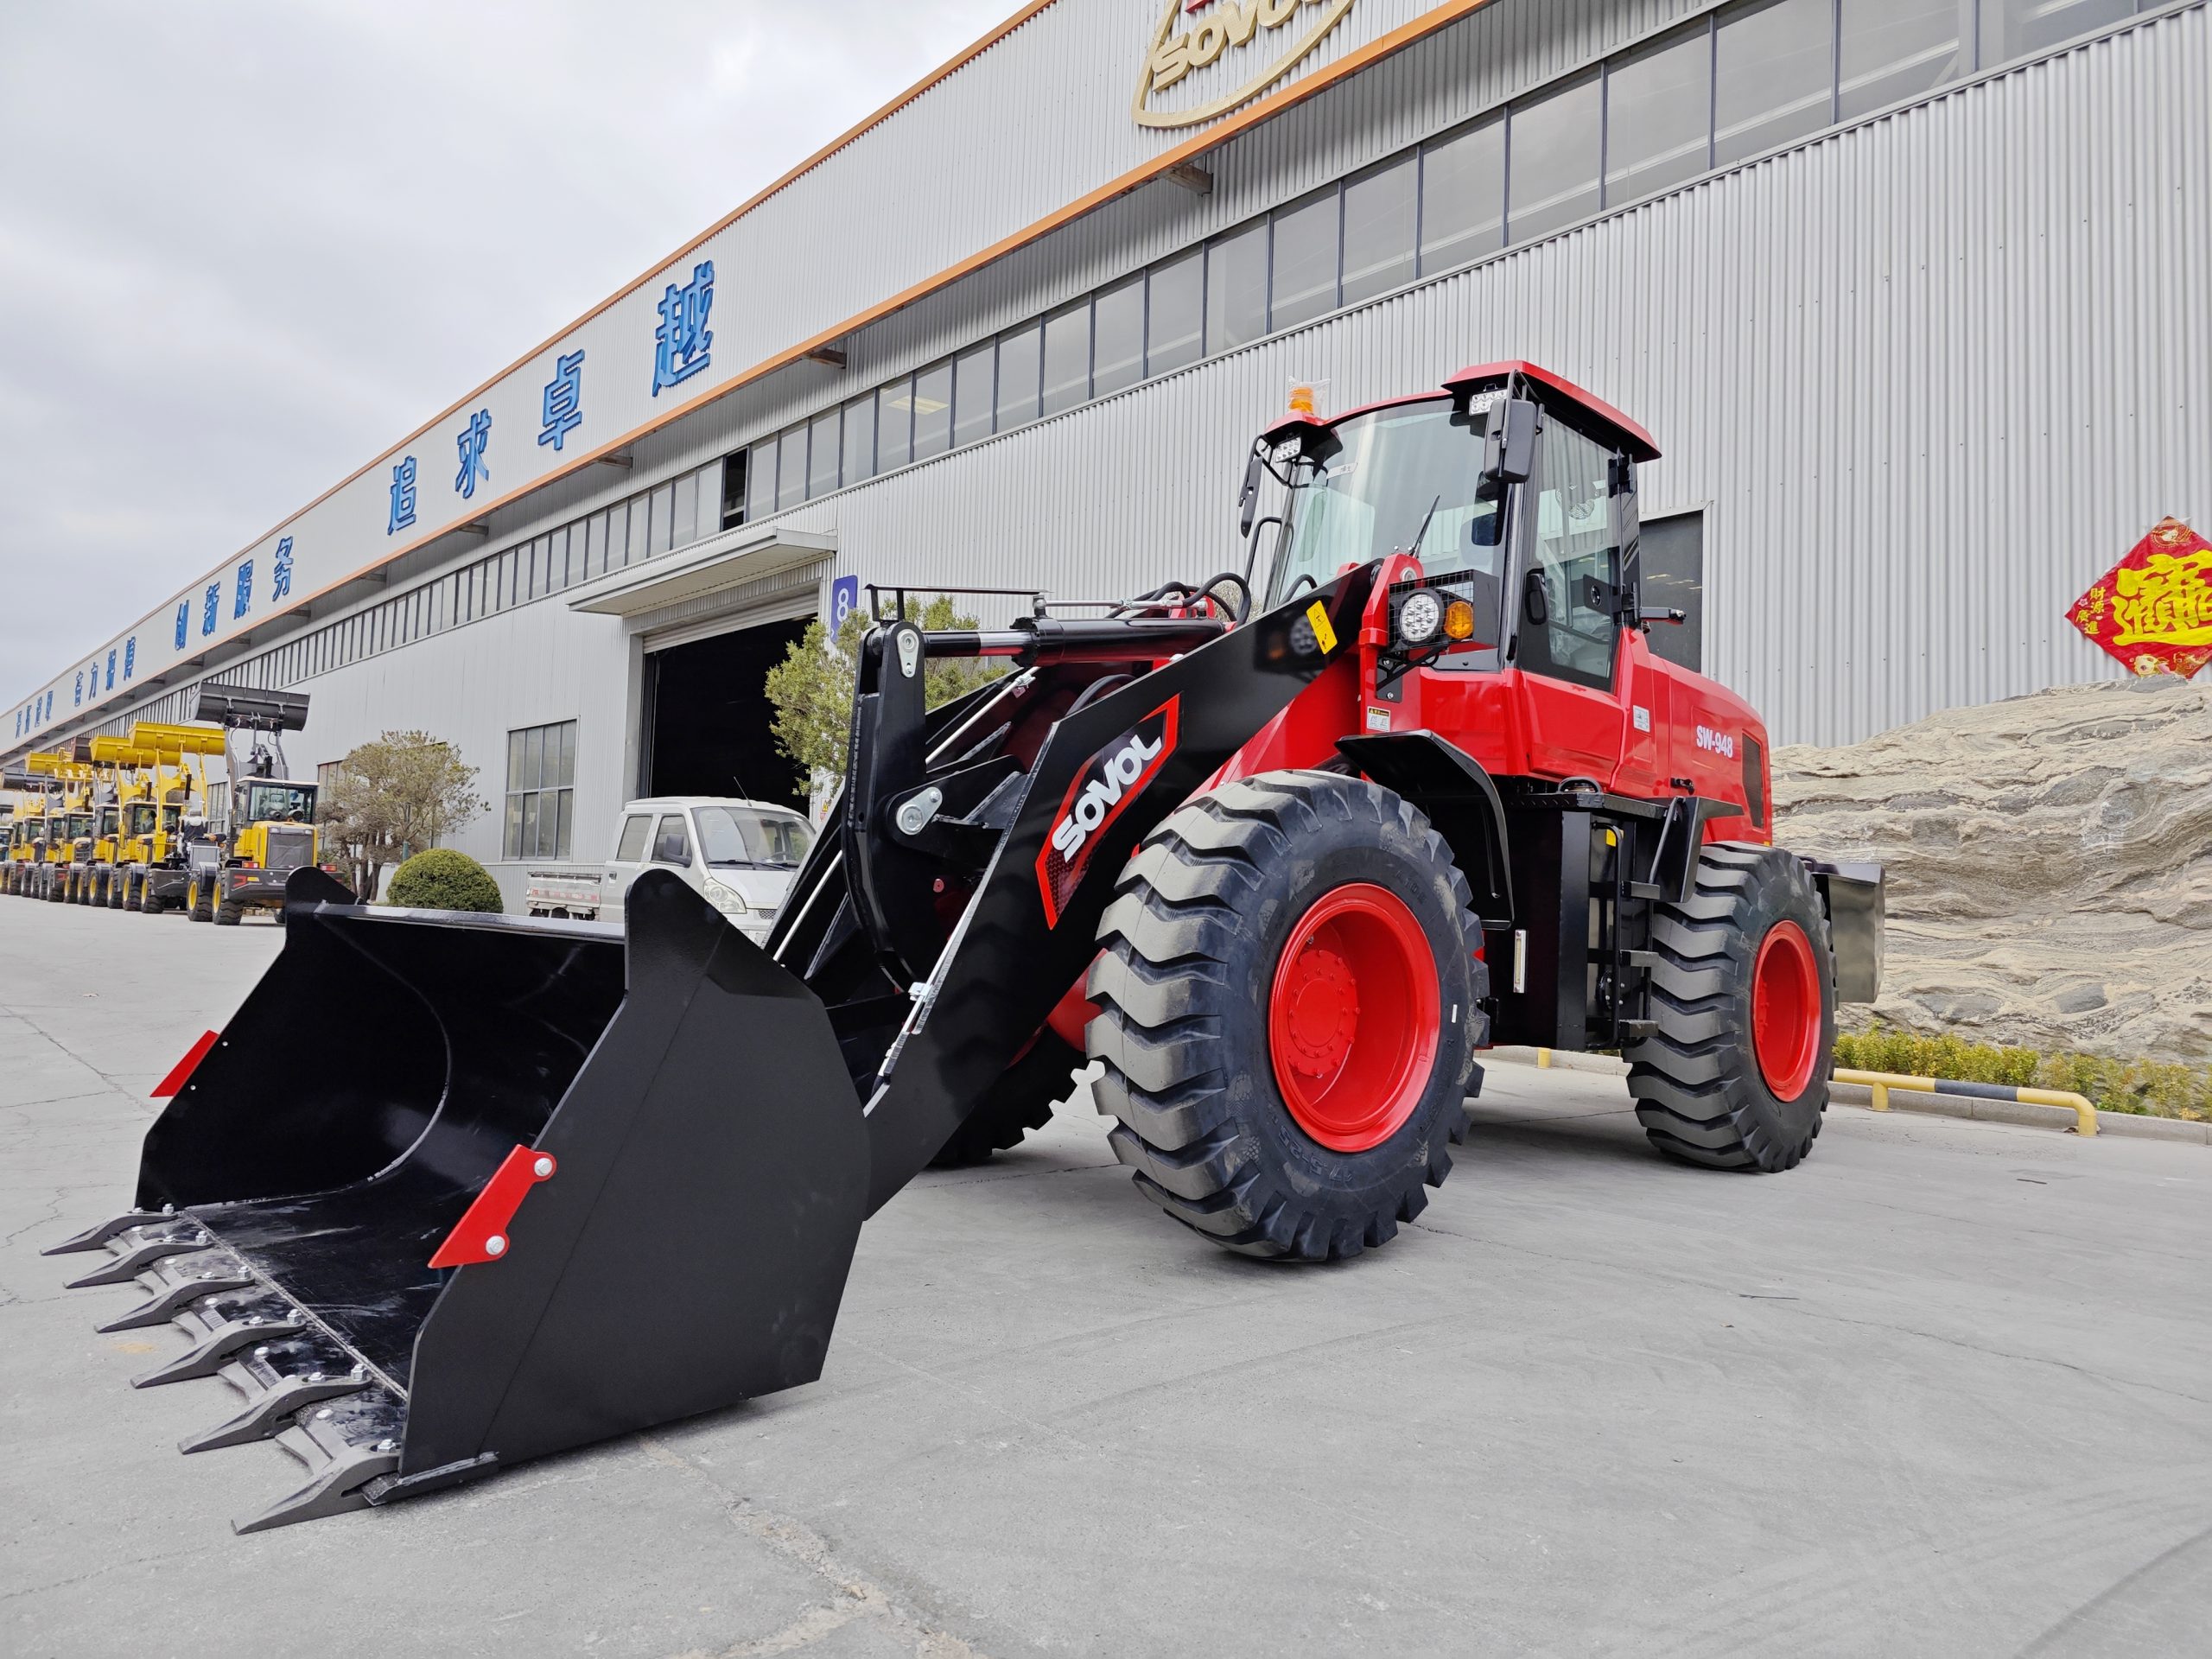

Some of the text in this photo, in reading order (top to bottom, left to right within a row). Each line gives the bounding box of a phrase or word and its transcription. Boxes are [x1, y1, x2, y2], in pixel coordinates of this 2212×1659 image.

[1151, 0, 1325, 93] SOVO
[386, 259, 715, 536] 追求卓越
[175, 536, 295, 651] 创新服务
[837, 588, 849, 622] 8
[1696, 725, 1733, 758] SW-948
[1052, 734, 1162, 863] SOVOL
